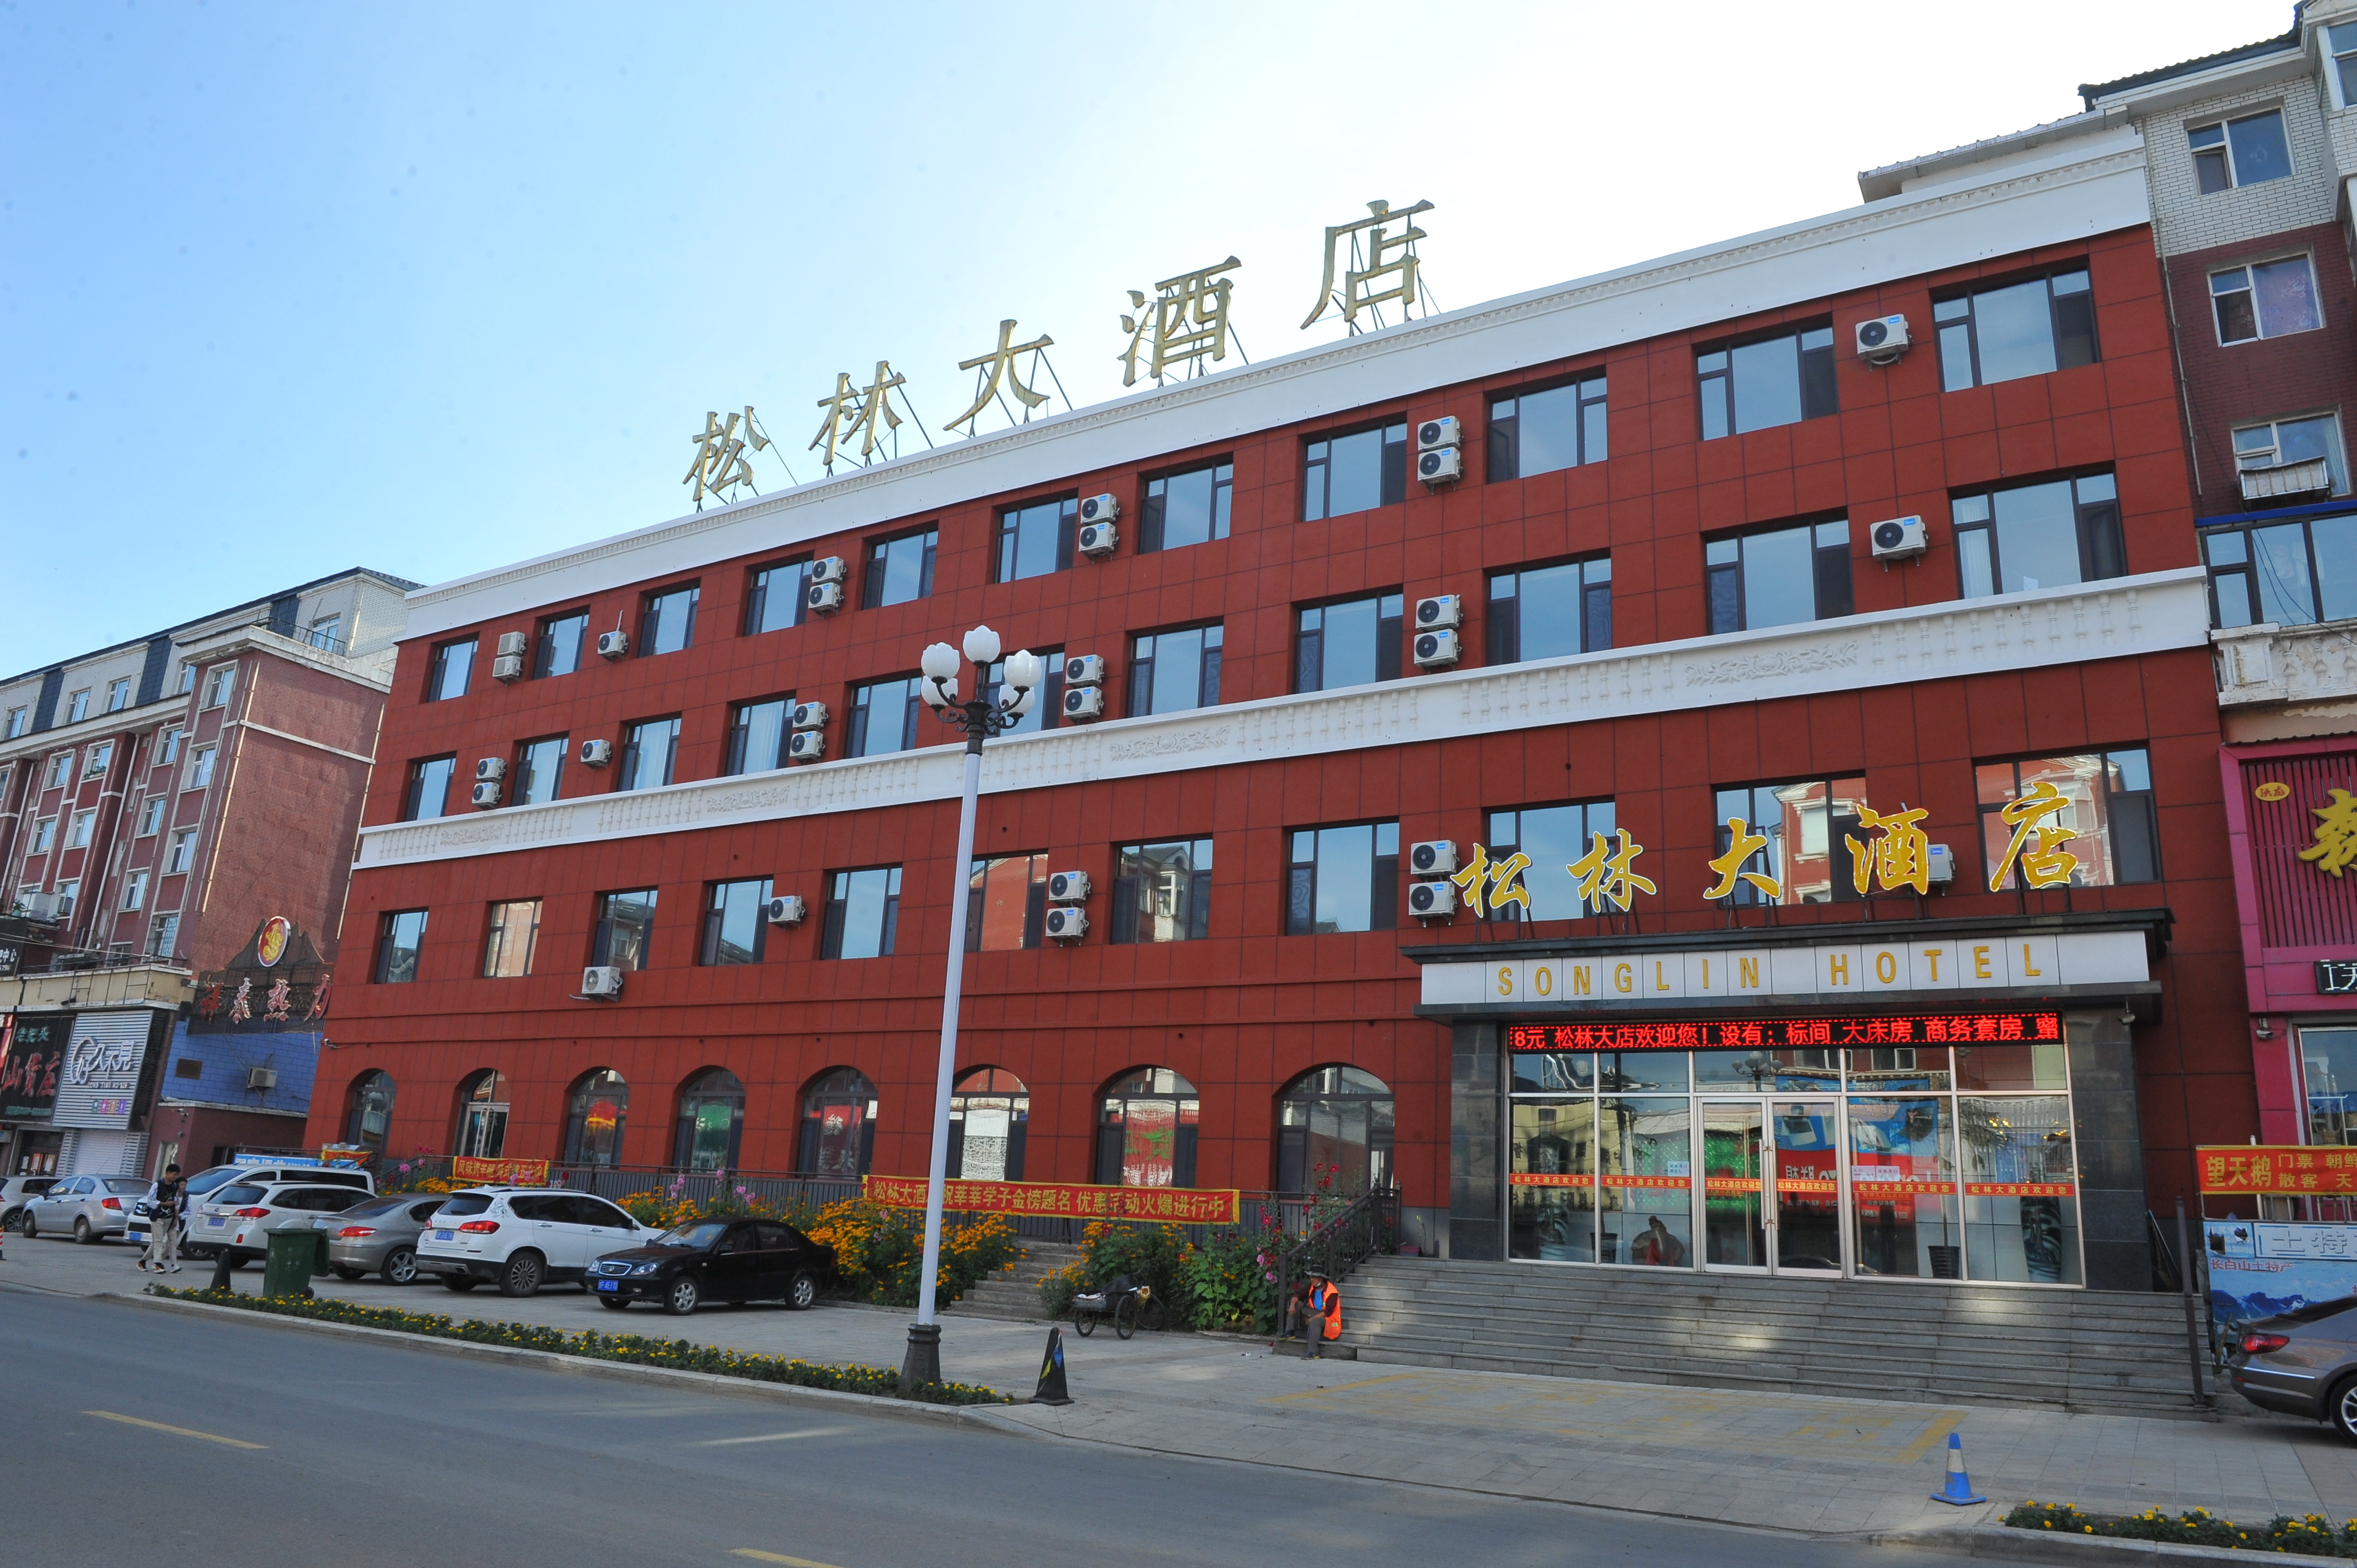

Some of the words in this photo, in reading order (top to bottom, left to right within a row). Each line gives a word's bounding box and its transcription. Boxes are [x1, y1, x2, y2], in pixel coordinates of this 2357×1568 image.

[683, 200, 1435, 502] 松林大酒店
[1450, 781, 2078, 919] 松林大酒店
[1497, 957, 1758, 996] SONGLIN
[1830, 943, 2042, 985] HOTEL
[2278, 1153, 2314, 1168] 门票
[2206, 1155, 2271, 1187] 望天鹅
[1515, 1175, 1589, 1185] 松林大酒店欢迎您
[1607, 1177, 1686, 1187] 松林大酒店欢迎您
[1778, 1180, 1835, 1190] 松林大酒店欢迎您
[2278, 1173, 2318, 1188] 散客
[1859, 1183, 1950, 1193] 松林大酒店欢迎您
[1971, 1185, 2067, 1194] 松林大酒店欢迎您
[874, 1180, 1072, 1211] 松林大酒祝莘莘学子金榜题名
[1076, 1190, 1224, 1219] 优惠活动火爆进行中
[2271, 1230, 2357, 1254] 土特
[2210, 1258, 2294, 1273] 长白山土特产
